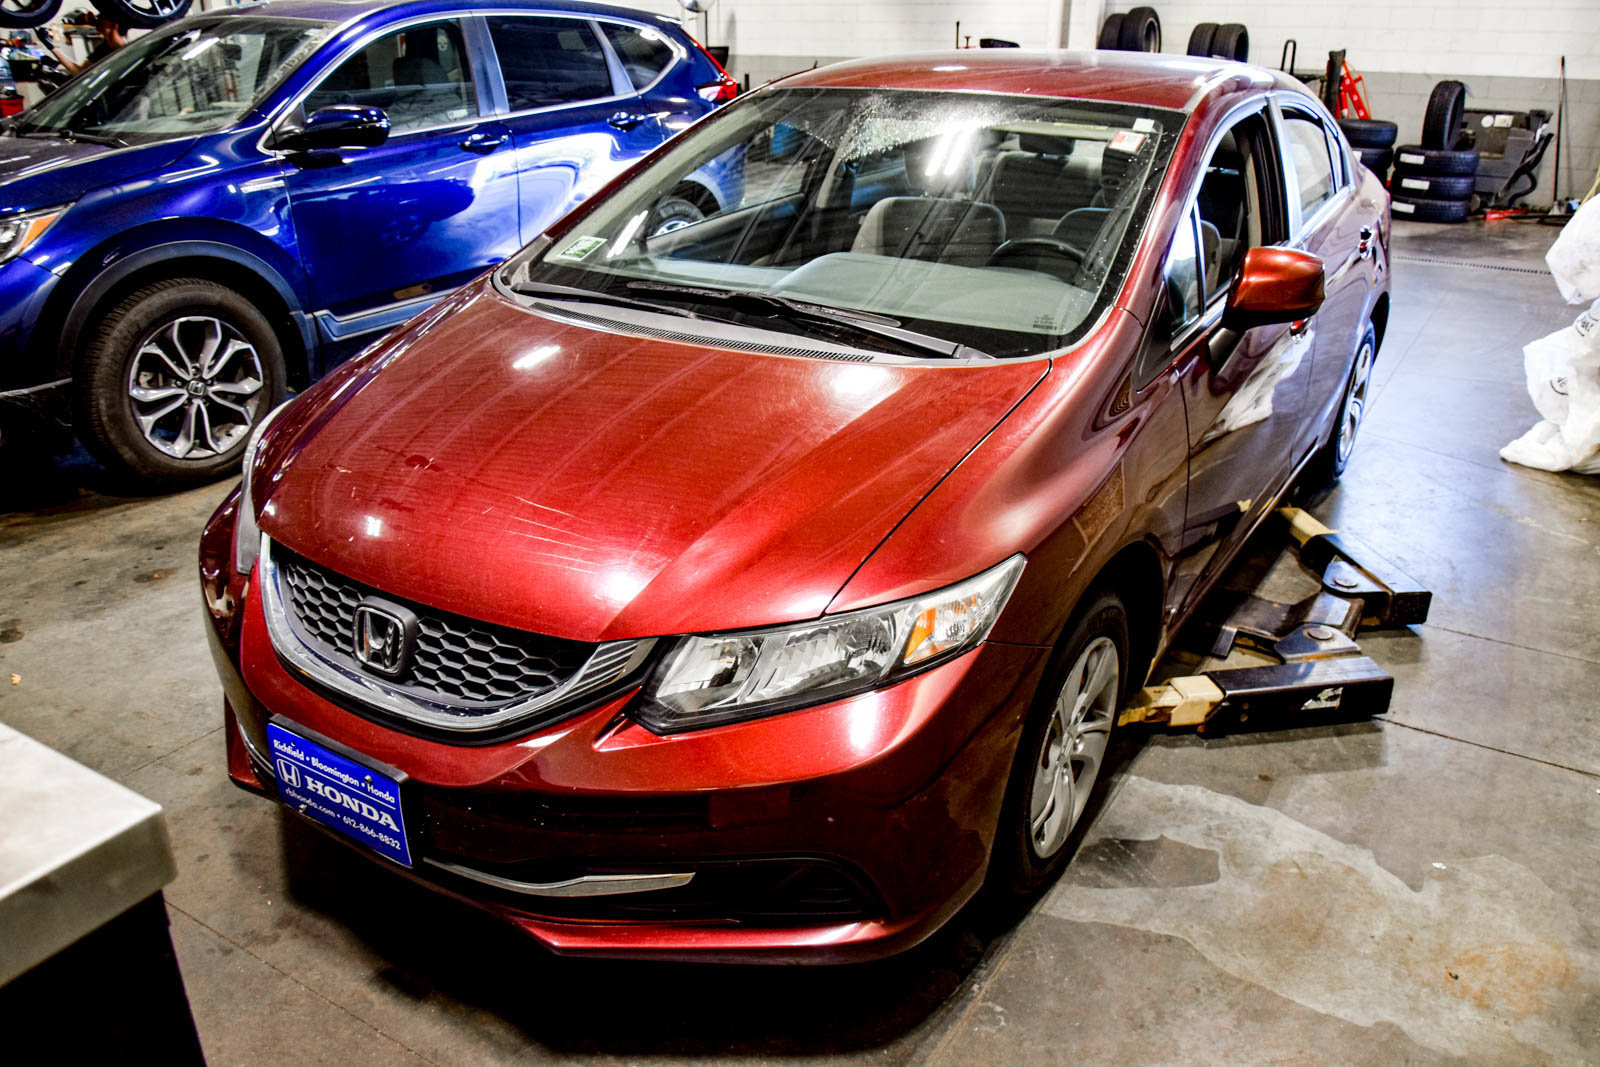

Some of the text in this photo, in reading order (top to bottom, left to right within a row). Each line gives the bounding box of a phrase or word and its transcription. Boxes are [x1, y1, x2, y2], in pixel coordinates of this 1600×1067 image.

[273, 739, 396, 804] Richfield Bloomington Honda
[304, 775, 400, 832] HONDA
[342, 815, 401, 850] 612-866-8832
